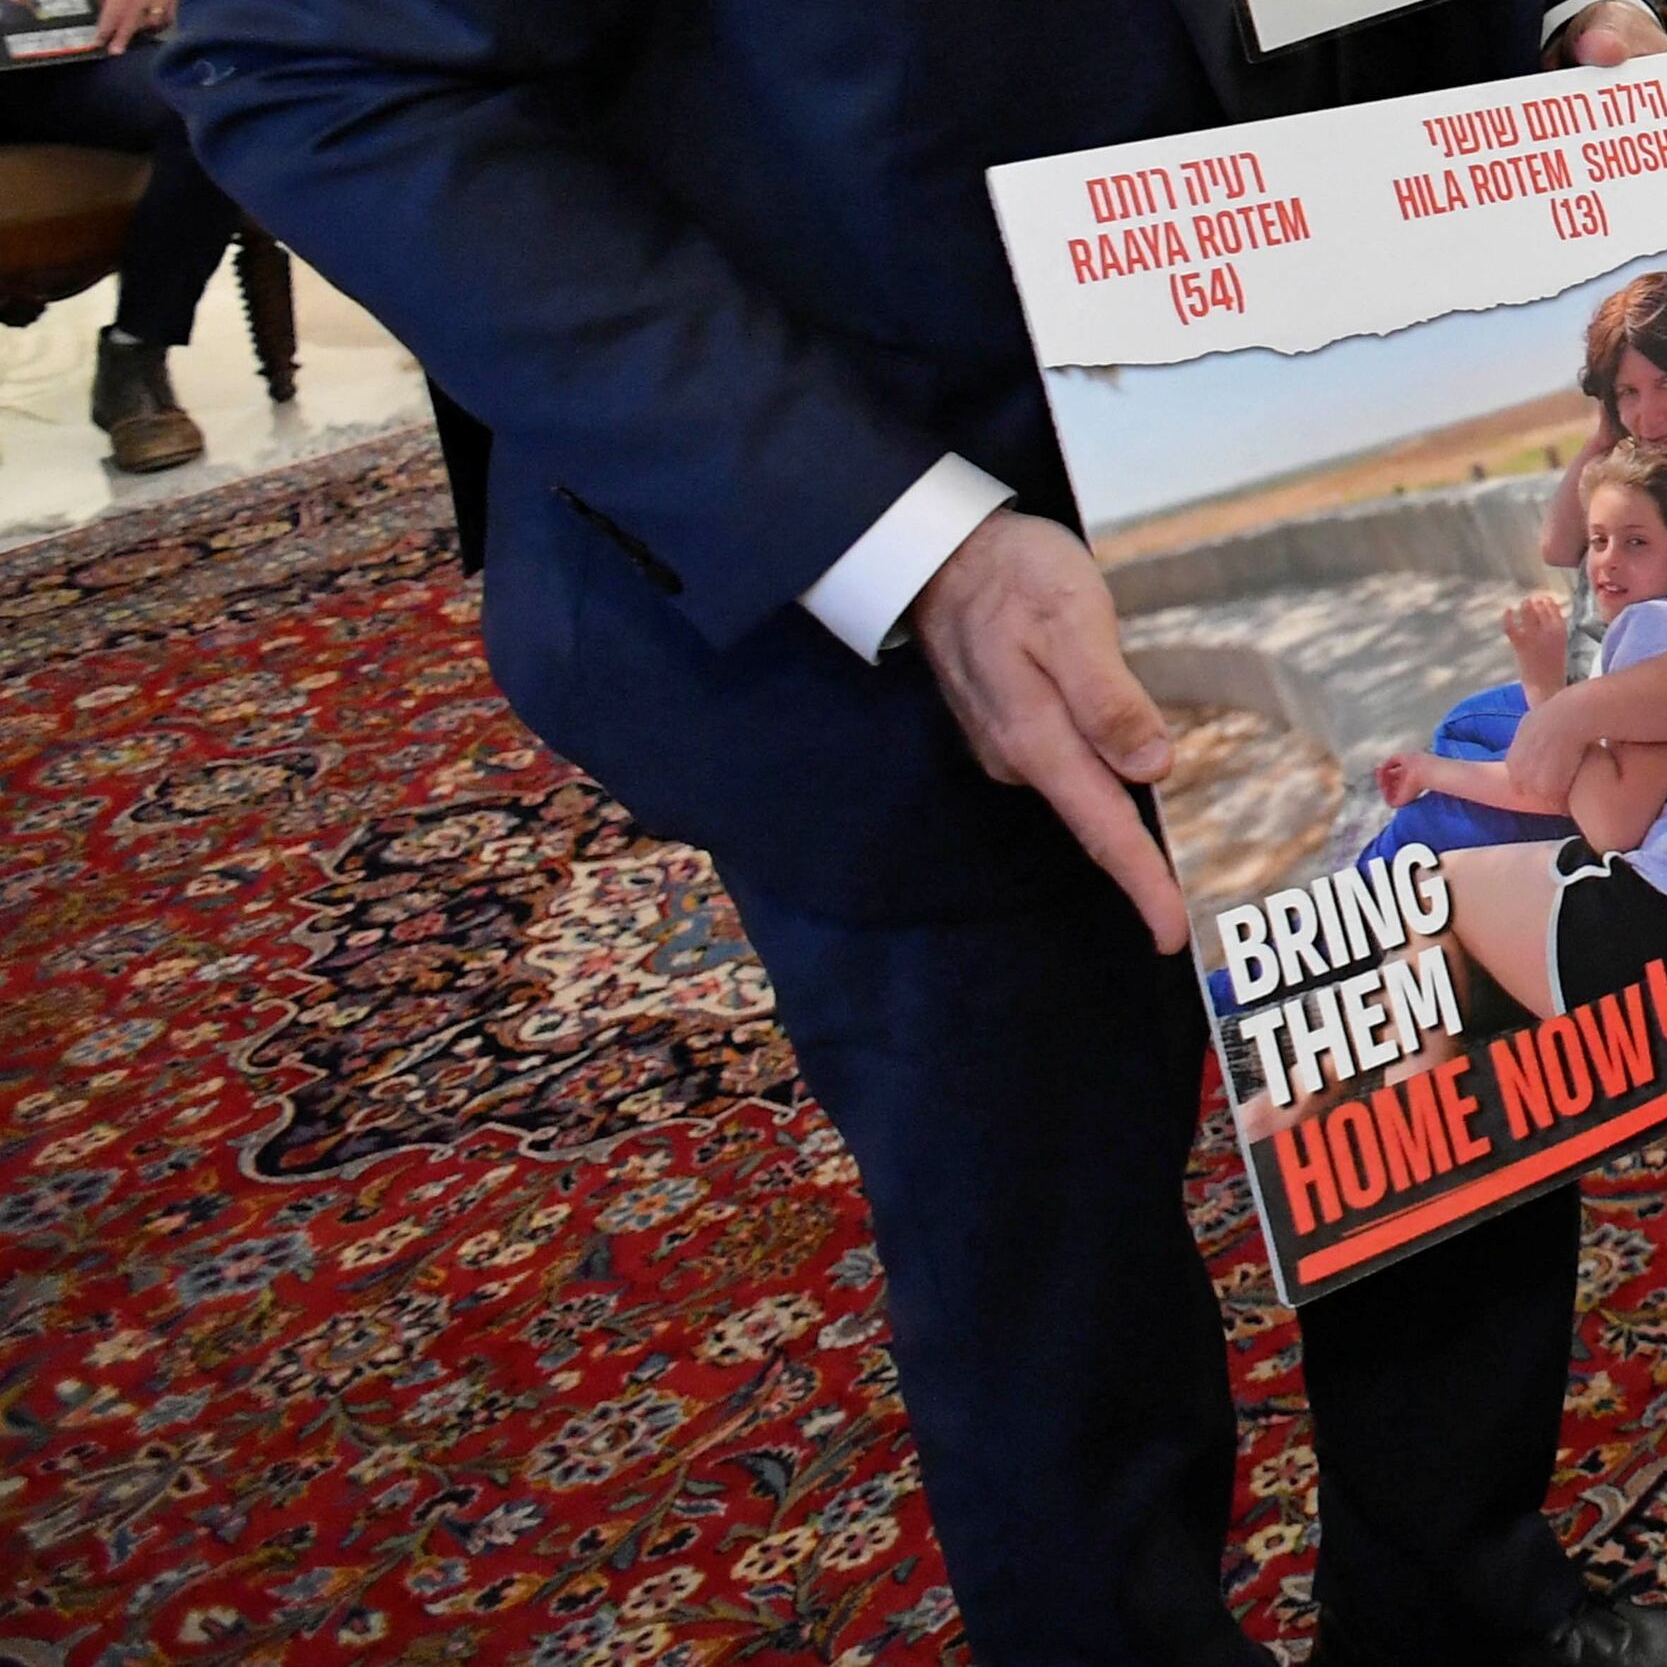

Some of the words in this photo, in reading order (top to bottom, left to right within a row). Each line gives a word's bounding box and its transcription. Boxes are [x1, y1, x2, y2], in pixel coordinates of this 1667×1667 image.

[1422, 105, 1520, 158] שושני
[1522, 92, 1597, 142] רותם
[1085, 167, 1178, 224] רותם
[1180, 151, 1267, 206] רעיה
[1393, 169, 1469, 221] HILA
[1468, 148, 1573, 206] ROTEM
[1067, 220, 1191, 285] RAAYA
[1192, 196, 1311, 260] ROTEM
[1550, 190, 1609, 241] (13)
[1169, 262, 1245, 326] (54)
[1217, 842, 1449, 1005] BRING
[1239, 945, 1464, 1107] THEM
[1272, 1056, 1492, 1236] HOME
